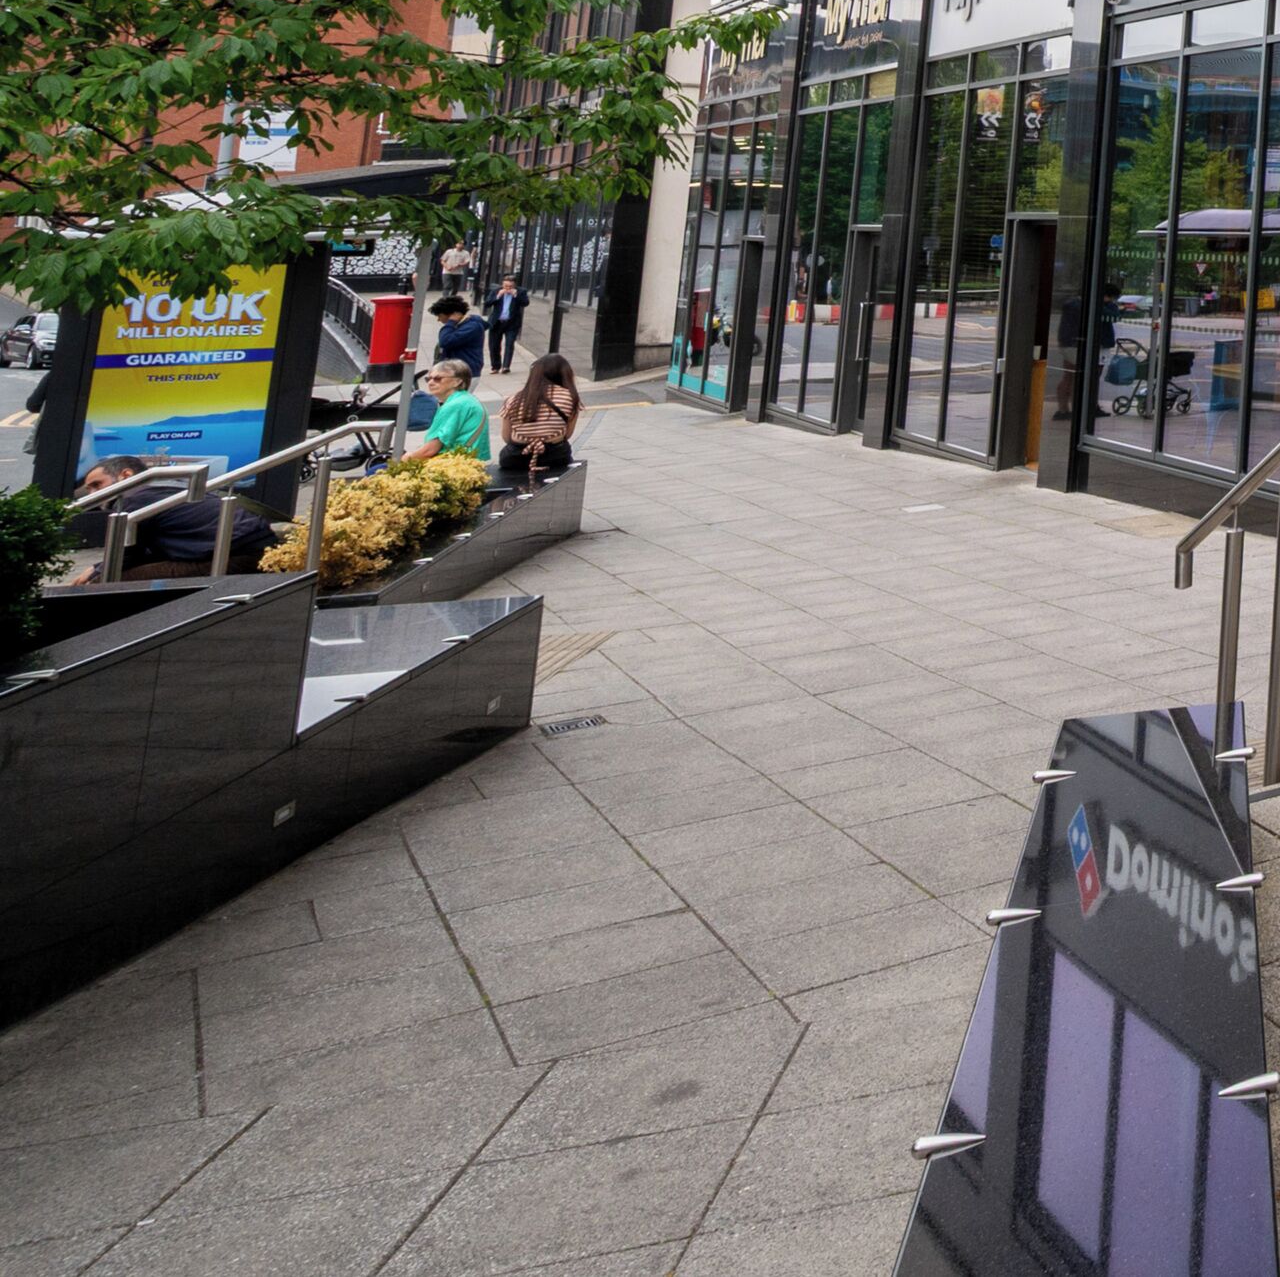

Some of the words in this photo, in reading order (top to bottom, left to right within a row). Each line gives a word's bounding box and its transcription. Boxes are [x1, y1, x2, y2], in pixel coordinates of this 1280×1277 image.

[124, 292, 182, 324] 10
[191, 290, 271, 323] UK
[116, 324, 265, 339] MILLIONAIRES
[126, 350, 246, 366] GUARANTEED
[147, 374, 175, 382] THIS
[178, 373, 221, 381] FRIDAY
